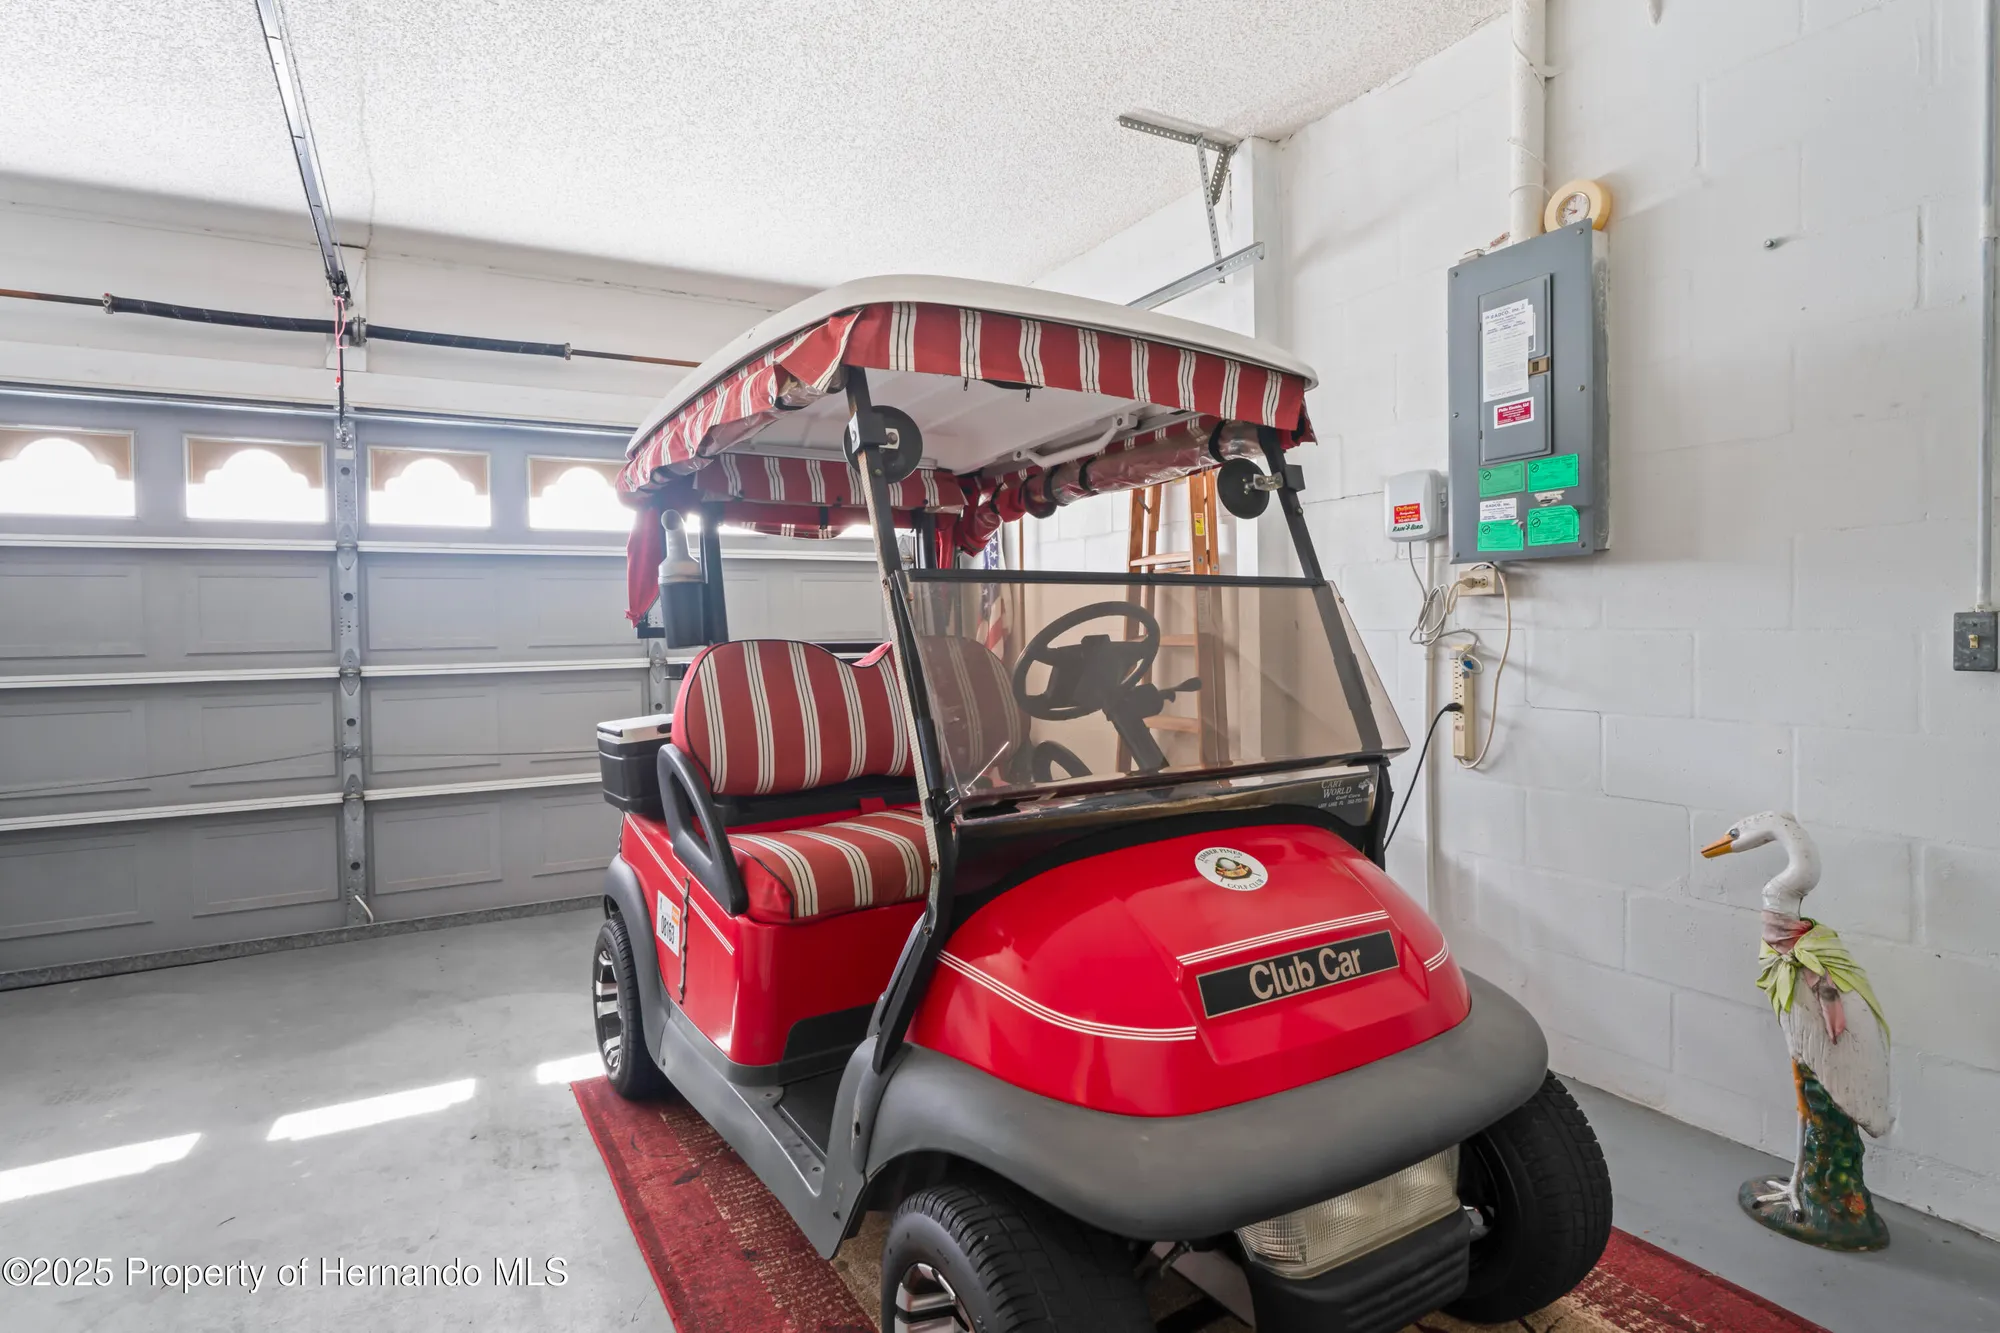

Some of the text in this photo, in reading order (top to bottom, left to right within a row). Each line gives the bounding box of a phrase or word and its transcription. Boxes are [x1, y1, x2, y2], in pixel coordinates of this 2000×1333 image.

[1321, 780, 1344, 789] CART
[1323, 786, 1352, 799] WORLD
[1197, 848, 1218, 862] TIMBER
[1218, 848, 1243, 857] PINES
[1248, 878, 1264, 889] CLUB
[1249, 947, 1361, 1000] Club Car
